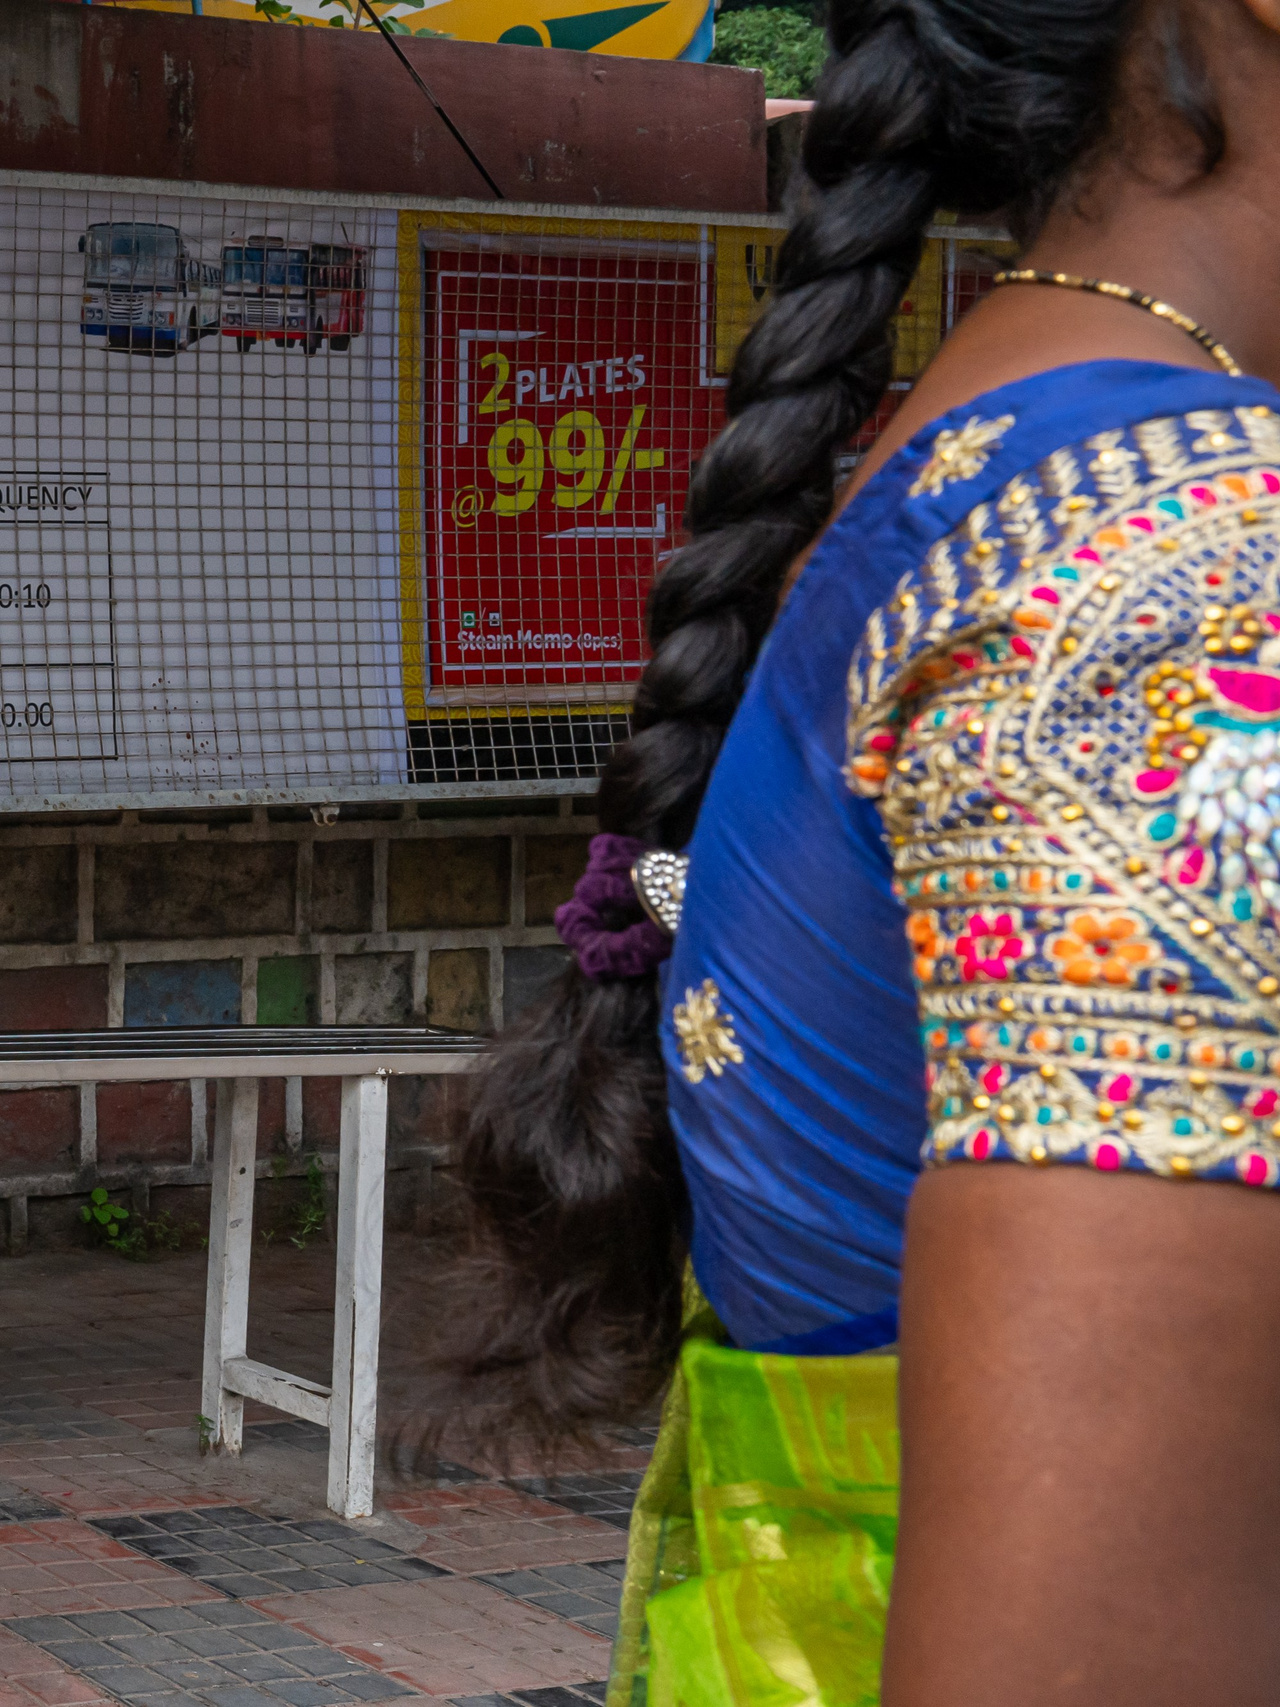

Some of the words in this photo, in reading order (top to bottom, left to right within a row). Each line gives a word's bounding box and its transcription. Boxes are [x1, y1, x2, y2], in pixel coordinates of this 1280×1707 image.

[478, 352, 511, 415] 2
[516, 353, 646, 406] PLATES
[451, 484, 484, 528] @
[487, 403, 665, 517] 99/-
[457, 630, 514, 651] Steam
